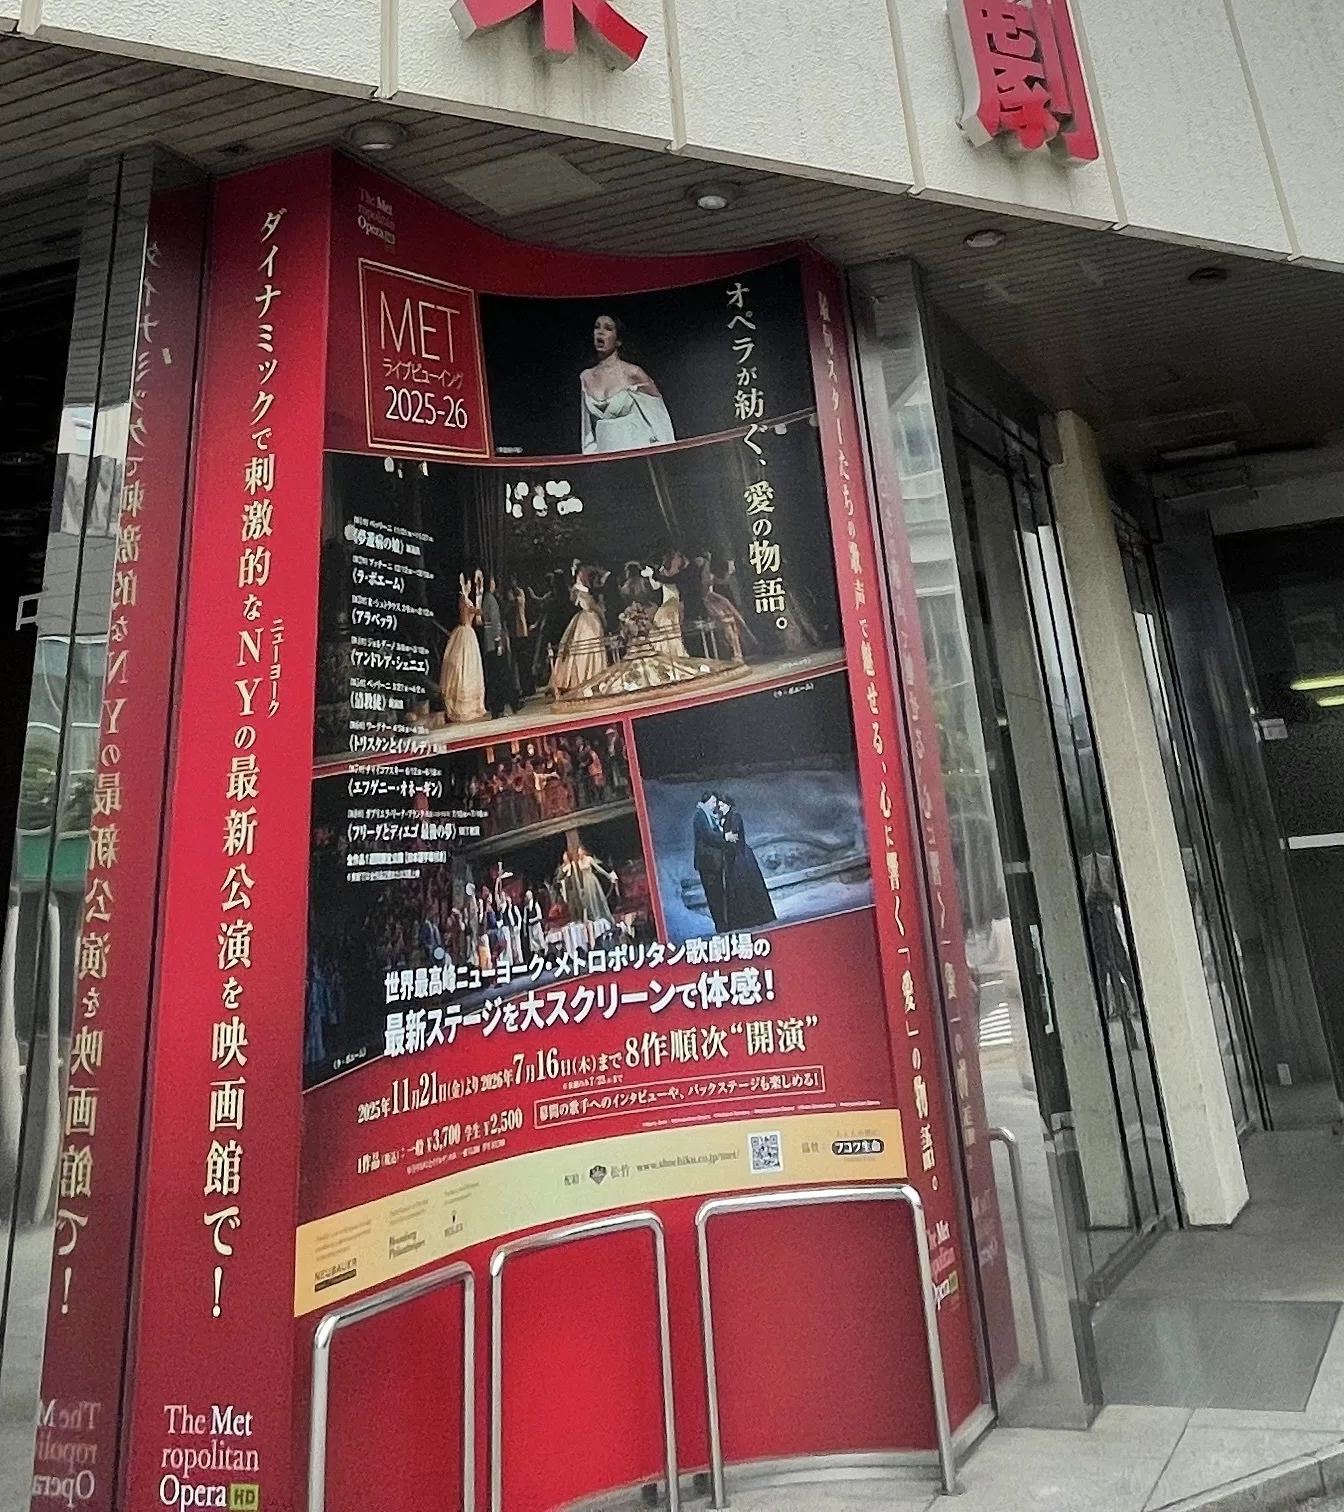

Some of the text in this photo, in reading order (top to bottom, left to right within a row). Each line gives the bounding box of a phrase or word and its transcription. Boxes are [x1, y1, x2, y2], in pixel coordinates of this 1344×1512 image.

[380, 291, 461, 363] MET
[383, 357, 463, 391] ライブビューイング
[385, 385, 468, 429] 2025-26
[726, 282, 788, 631] オペラが紡ぐ、愛の物語。
[268, 617, 286, 719] ニューヨーク
[384, 934, 772, 1004] 世界最高峰ニューヨーク・メトロポリタン歌劇場の
[383, 968, 775, 1057] 最新ステージを大スクリーンで体感!
[164, 1404, 254, 1436] The Met
[161, 1439, 260, 1479] ropolitan
[159, 1474, 227, 1512] Opera
